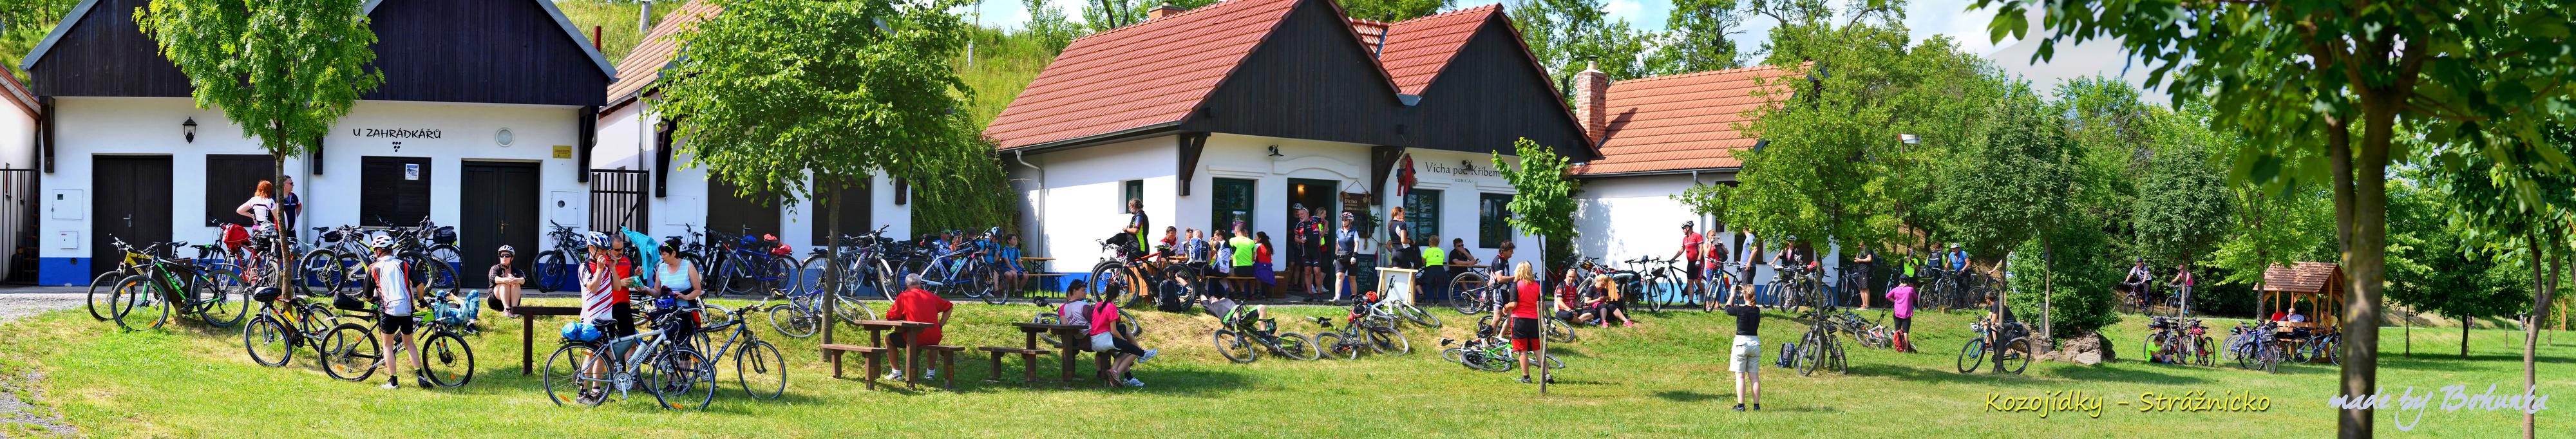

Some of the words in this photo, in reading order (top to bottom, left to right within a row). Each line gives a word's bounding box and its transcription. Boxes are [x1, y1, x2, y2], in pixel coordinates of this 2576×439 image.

[353, 128, 361, 136] U
[366, 127, 442, 139] ZAHRÁDKÁŘŮ
[1425, 162, 1450, 174] Vícha
[1471, 165, 1501, 177] Kříbem
[634, 345, 654, 368] AUTHOR
